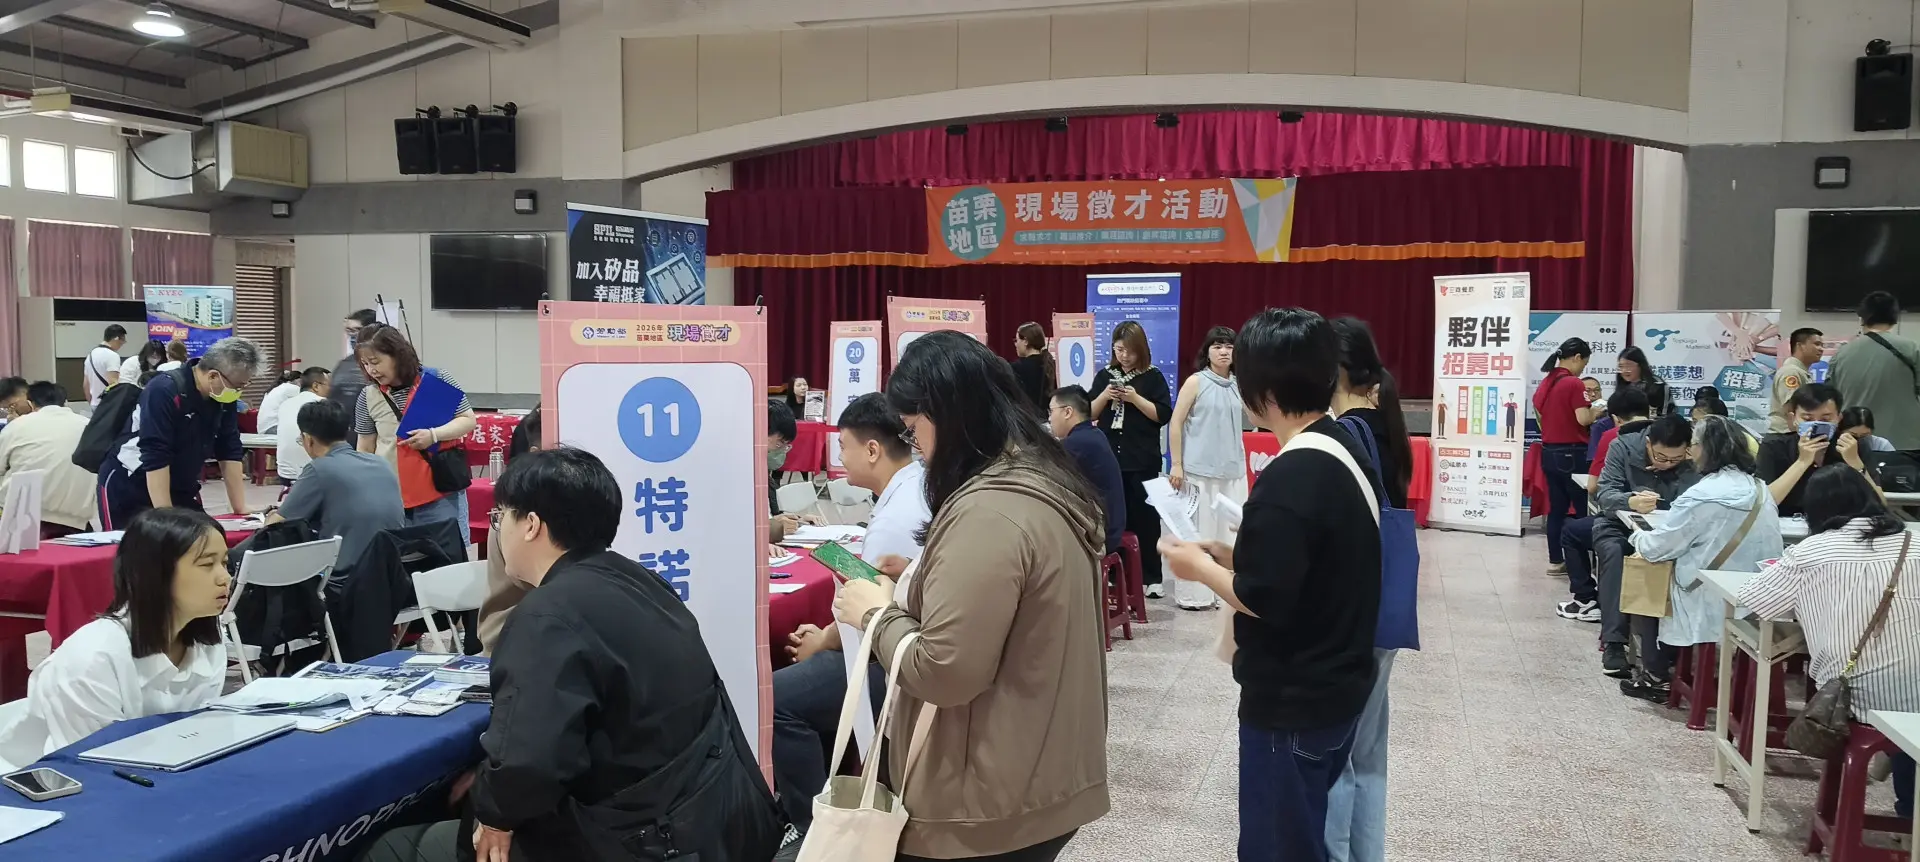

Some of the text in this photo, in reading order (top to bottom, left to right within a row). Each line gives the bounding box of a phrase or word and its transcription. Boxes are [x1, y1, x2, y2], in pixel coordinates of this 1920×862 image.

[945, 192, 998, 226] 苗栗
[1014, 187, 1229, 223] 現場徵才活動
[593, 223, 615, 237] SPIL
[948, 222, 1000, 254] 地區
[575, 257, 640, 284] 加入矽品
[150, 325, 187, 337] JOIN US
[636, 324, 664, 333] 2026年
[667, 323, 733, 343] 現場徵才
[1447, 316, 1511, 348] 夥伴
[849, 347, 861, 358] 20
[1585, 341, 1617, 354] 科技
[1074, 352, 1081, 367] 9
[1442, 352, 1514, 377] 招募中
[1723, 369, 1764, 390] 招募
[1809, 368, 1829, 381] 17
[1668, 386, 1699, 400] 等你
[636, 402, 680, 437] 11
[258, 778, 444, 862] HNOPR
